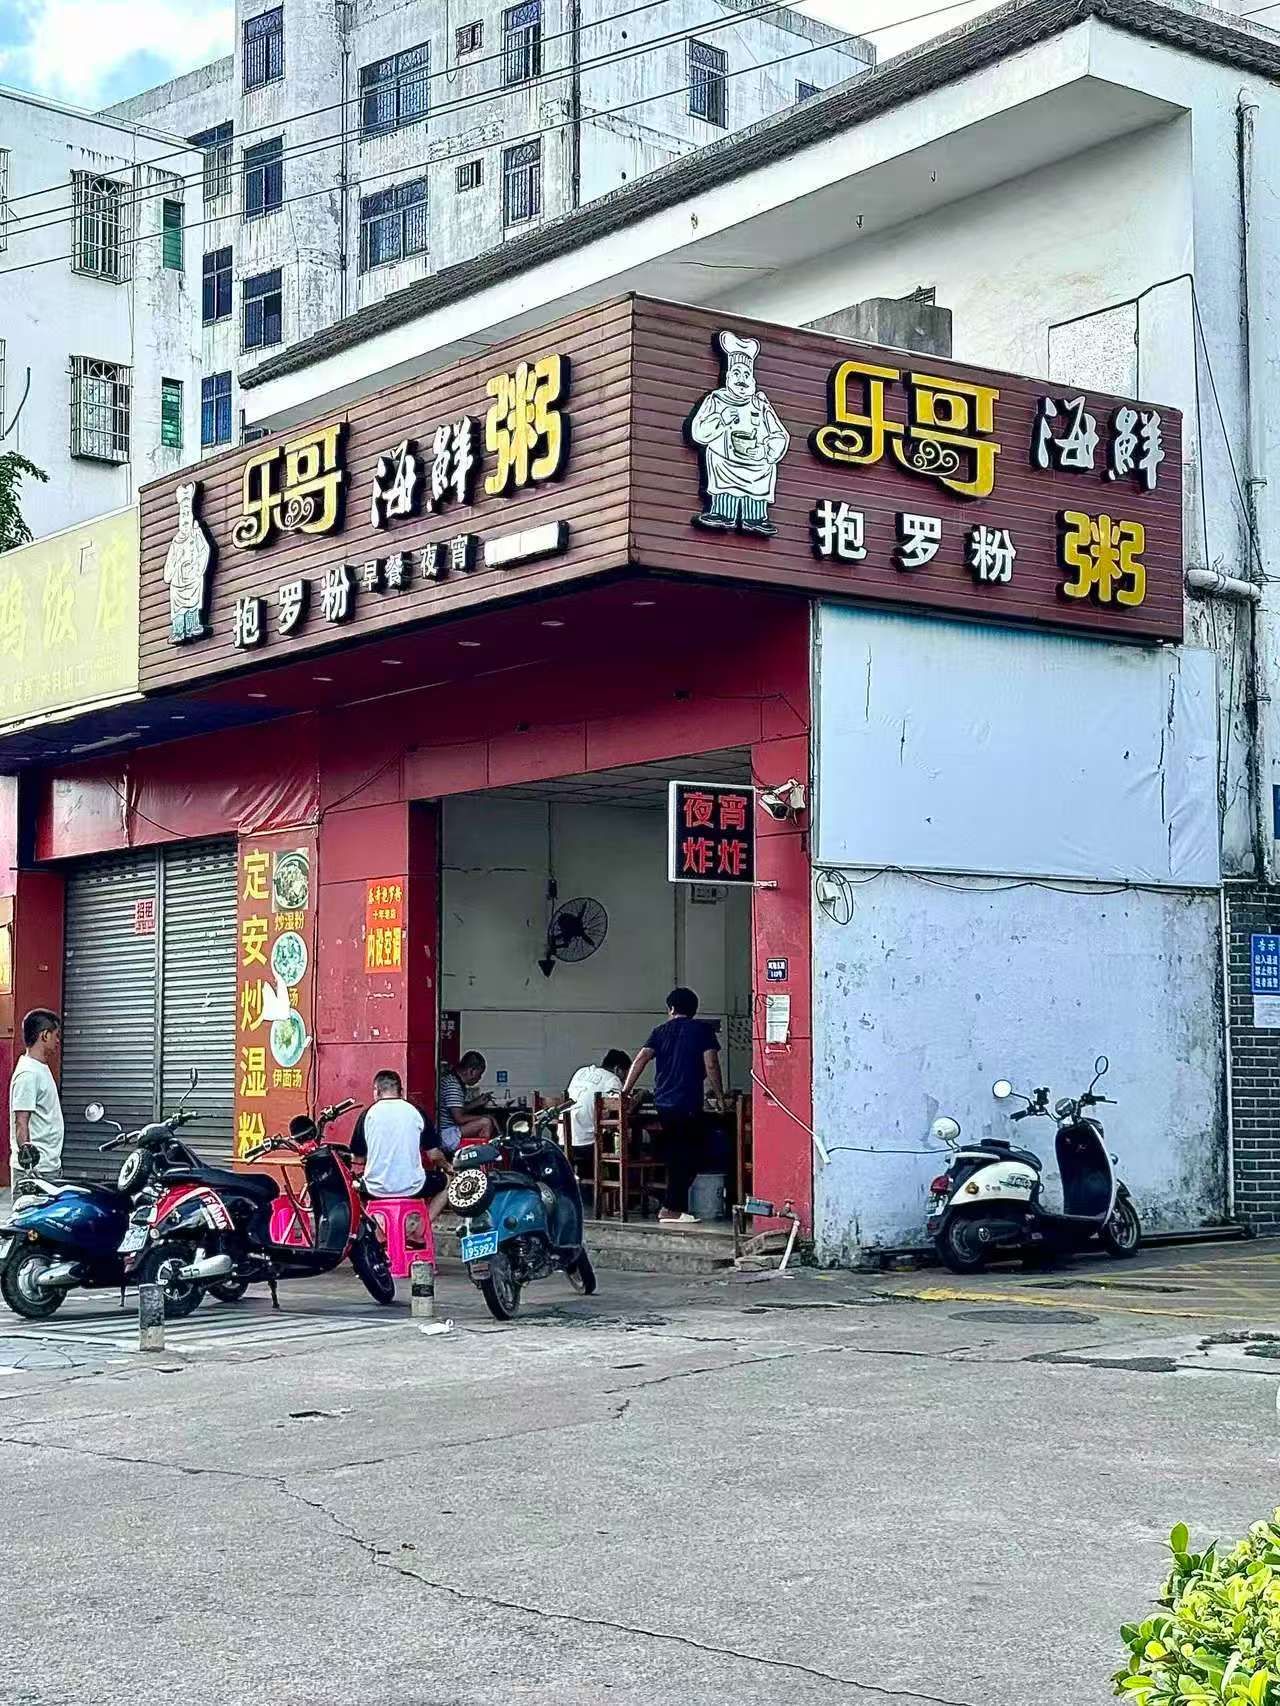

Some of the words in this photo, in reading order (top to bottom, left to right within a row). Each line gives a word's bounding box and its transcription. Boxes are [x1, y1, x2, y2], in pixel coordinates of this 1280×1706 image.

[815, 360, 1001, 497] 乐哥
[1038, 396, 1165, 490] 海鲜
[231, 422, 343, 549] 乐哥
[817, 501, 1017, 583] 抱罗粉
[1063, 510, 1146, 606] 粥
[232, 565, 350, 648] 抱罗粉
[361, 551, 408, 592] 早餐
[419, 534, 470, 578] 夜宵
[683, 792, 748, 830] 夜宵
[682, 837, 748, 875] 炸炸
[274, 913, 305, 930] 炒湿粉
[237, 848, 271, 1159] 定安炒湿粉
[272, 1069, 303, 1089] 伊面汤
